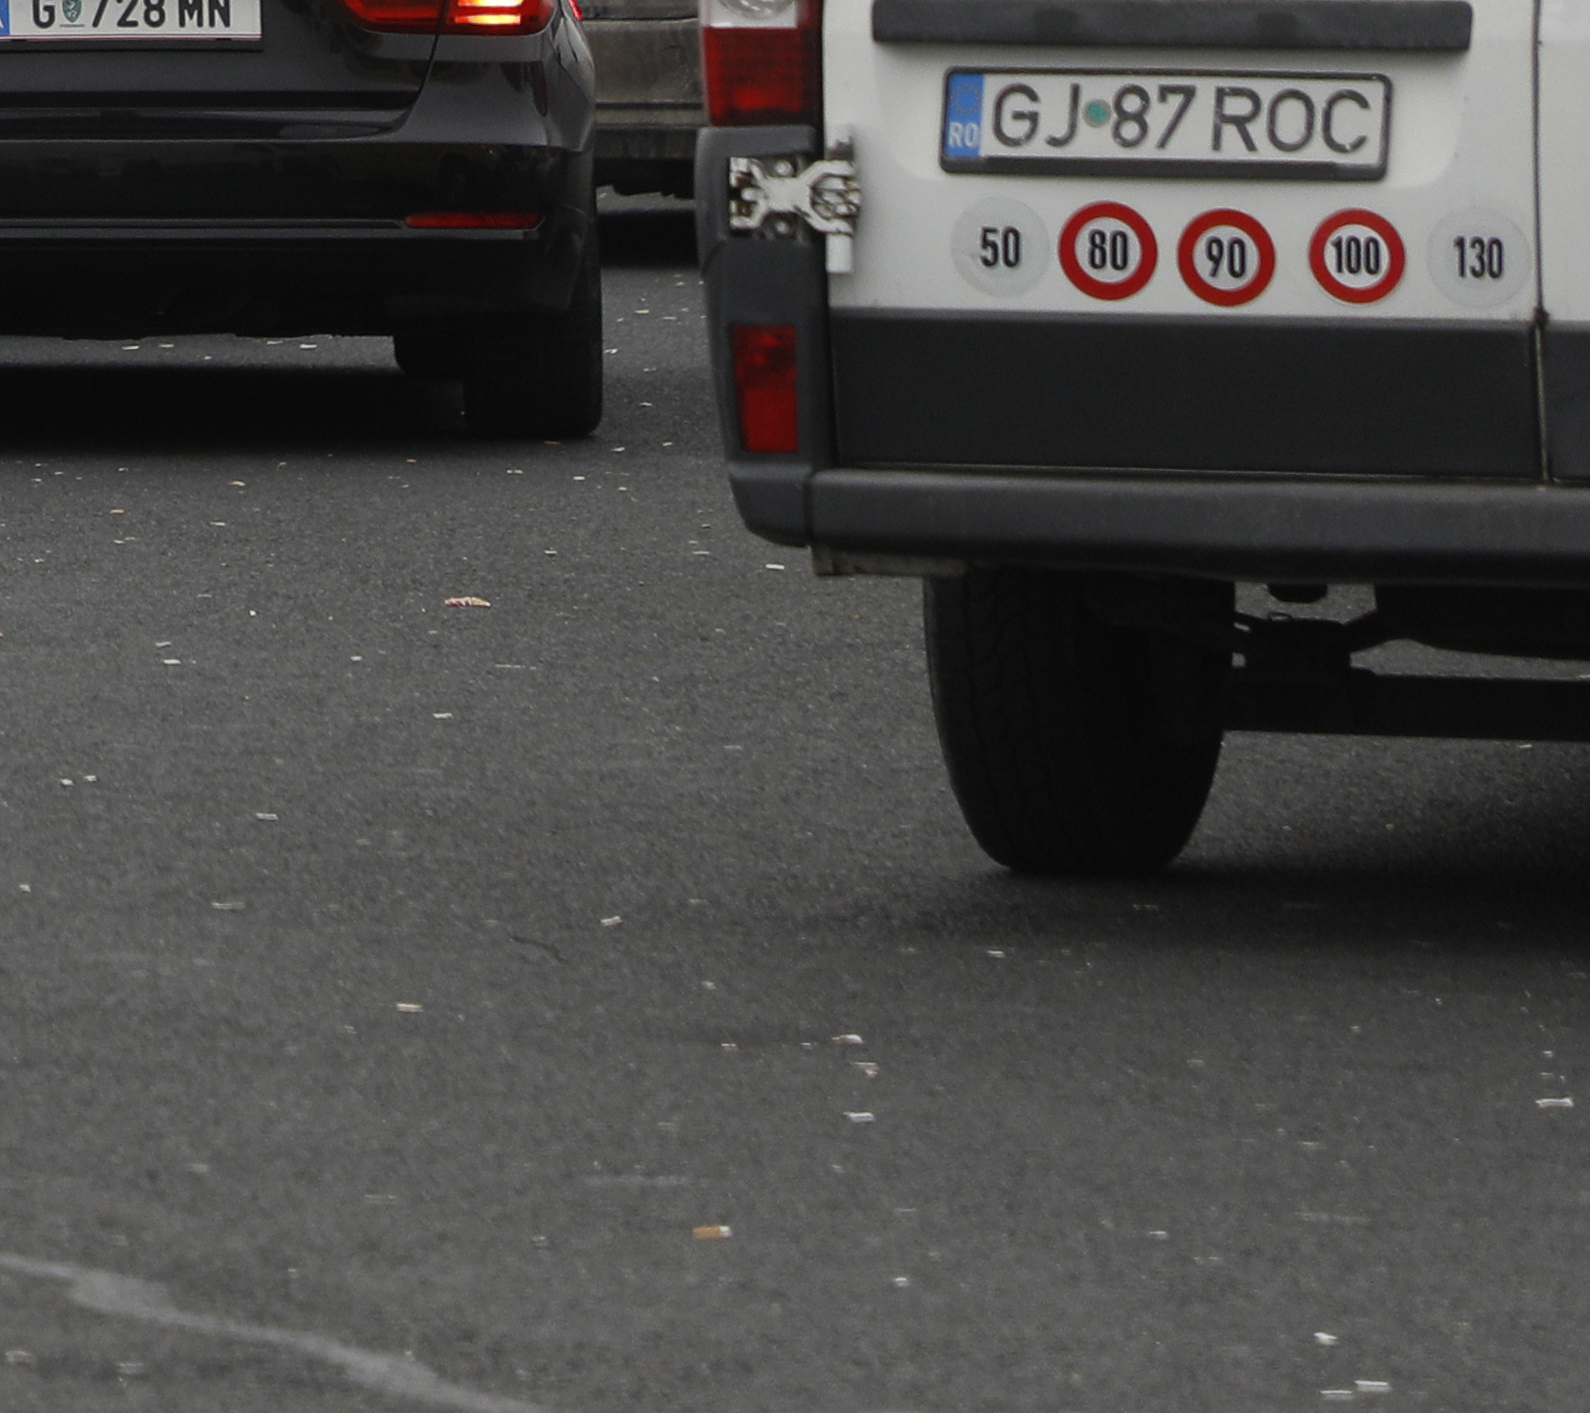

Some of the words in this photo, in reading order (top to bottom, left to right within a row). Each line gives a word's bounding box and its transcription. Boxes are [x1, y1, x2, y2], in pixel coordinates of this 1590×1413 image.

[948, 122, 979, 148] RO
[992, 83, 1081, 147] GJ
[1112, 84, 1197, 149] 87
[1211, 86, 1371, 154] ROC
[980, 226, 1020, 269] 50
[1087, 230, 1129, 271] 80
[1205, 236, 1246, 279] 90
[1332, 235, 1381, 275] 100
[1453, 236, 1503, 279] 130
